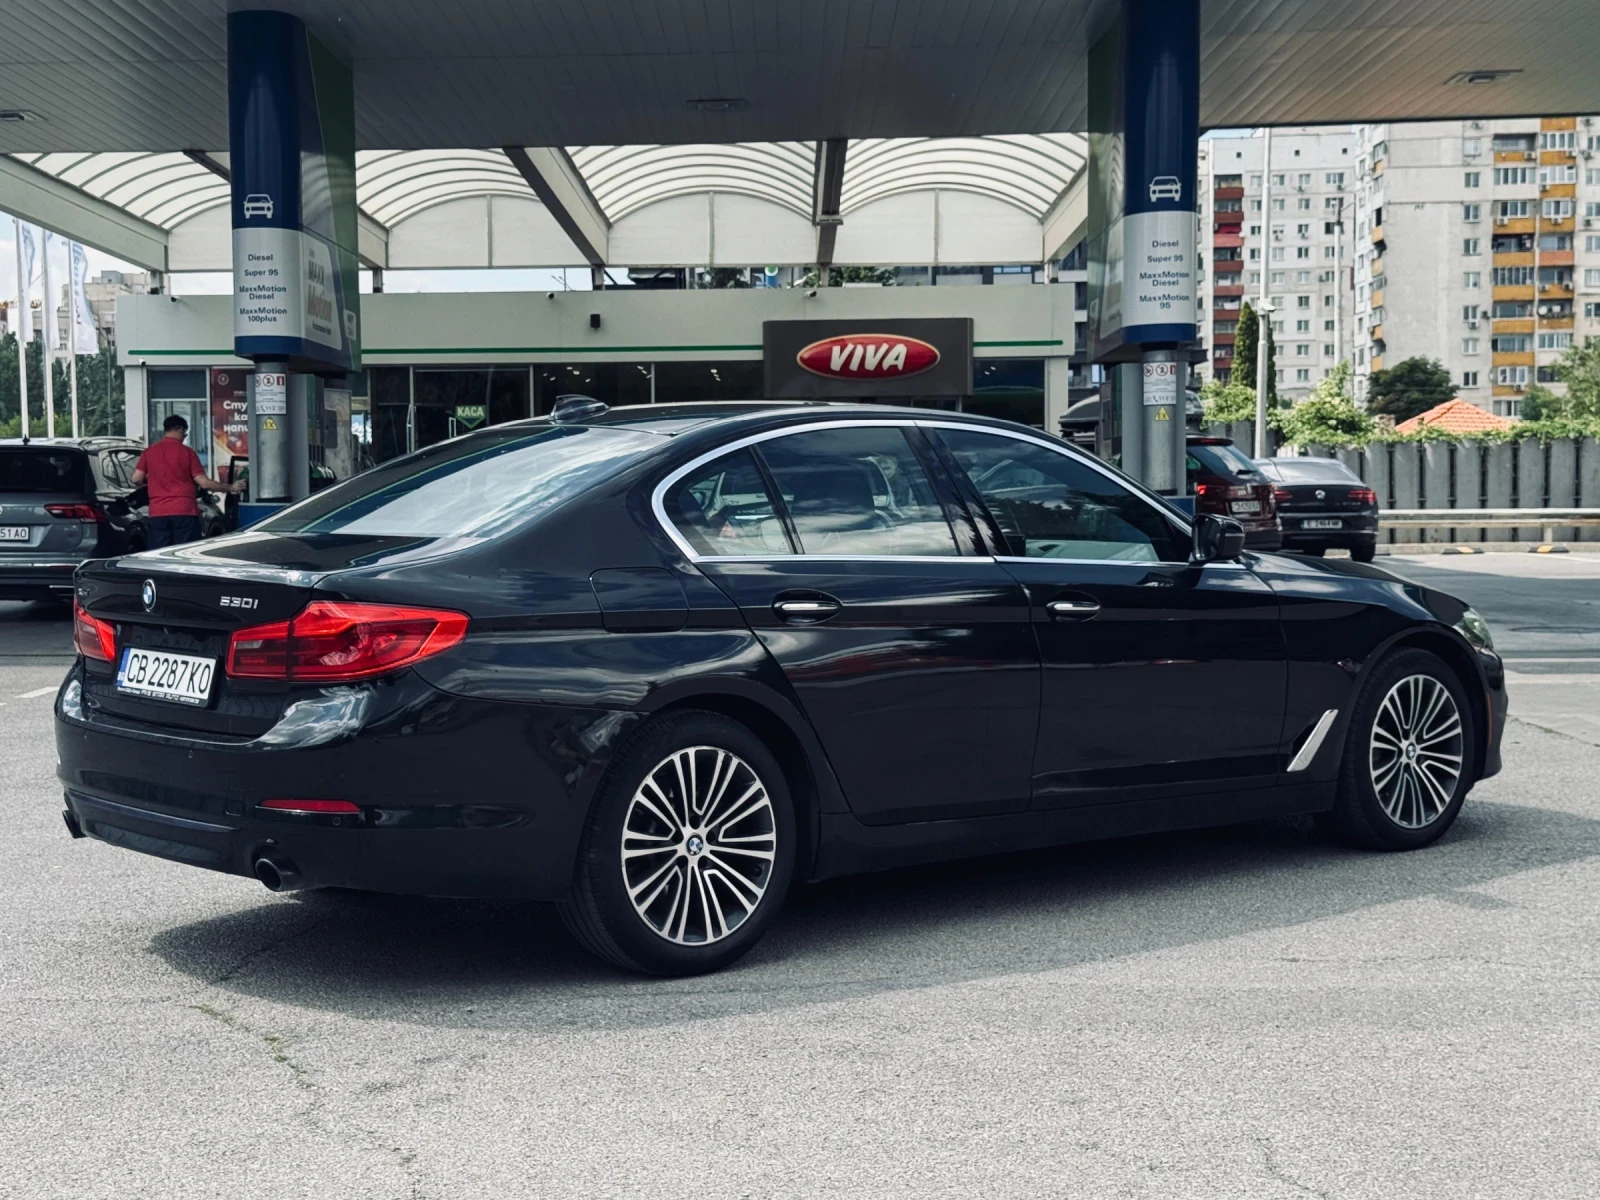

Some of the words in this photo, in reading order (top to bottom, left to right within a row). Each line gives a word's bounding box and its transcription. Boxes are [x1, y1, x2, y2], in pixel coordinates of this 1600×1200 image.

[1152, 240, 1179, 248] Diesel
[1147, 255, 1172, 264] Super
[1173, 254, 1183, 262] 95
[244, 269, 266, 277] Super
[268, 268, 279, 276] 95
[1139, 271, 1190, 280] MaxxMotion
[1152, 279, 1179, 287] Diesel
[239, 285, 287, 293] MaxxMotion
[1139, 294, 1190, 303] MaxxMotion
[239, 307, 288, 315] MaxxMotion
[248, 315, 277, 323] 100plus
[830, 342, 908, 371] VIVA
[457, 406, 485, 417] КАСА
